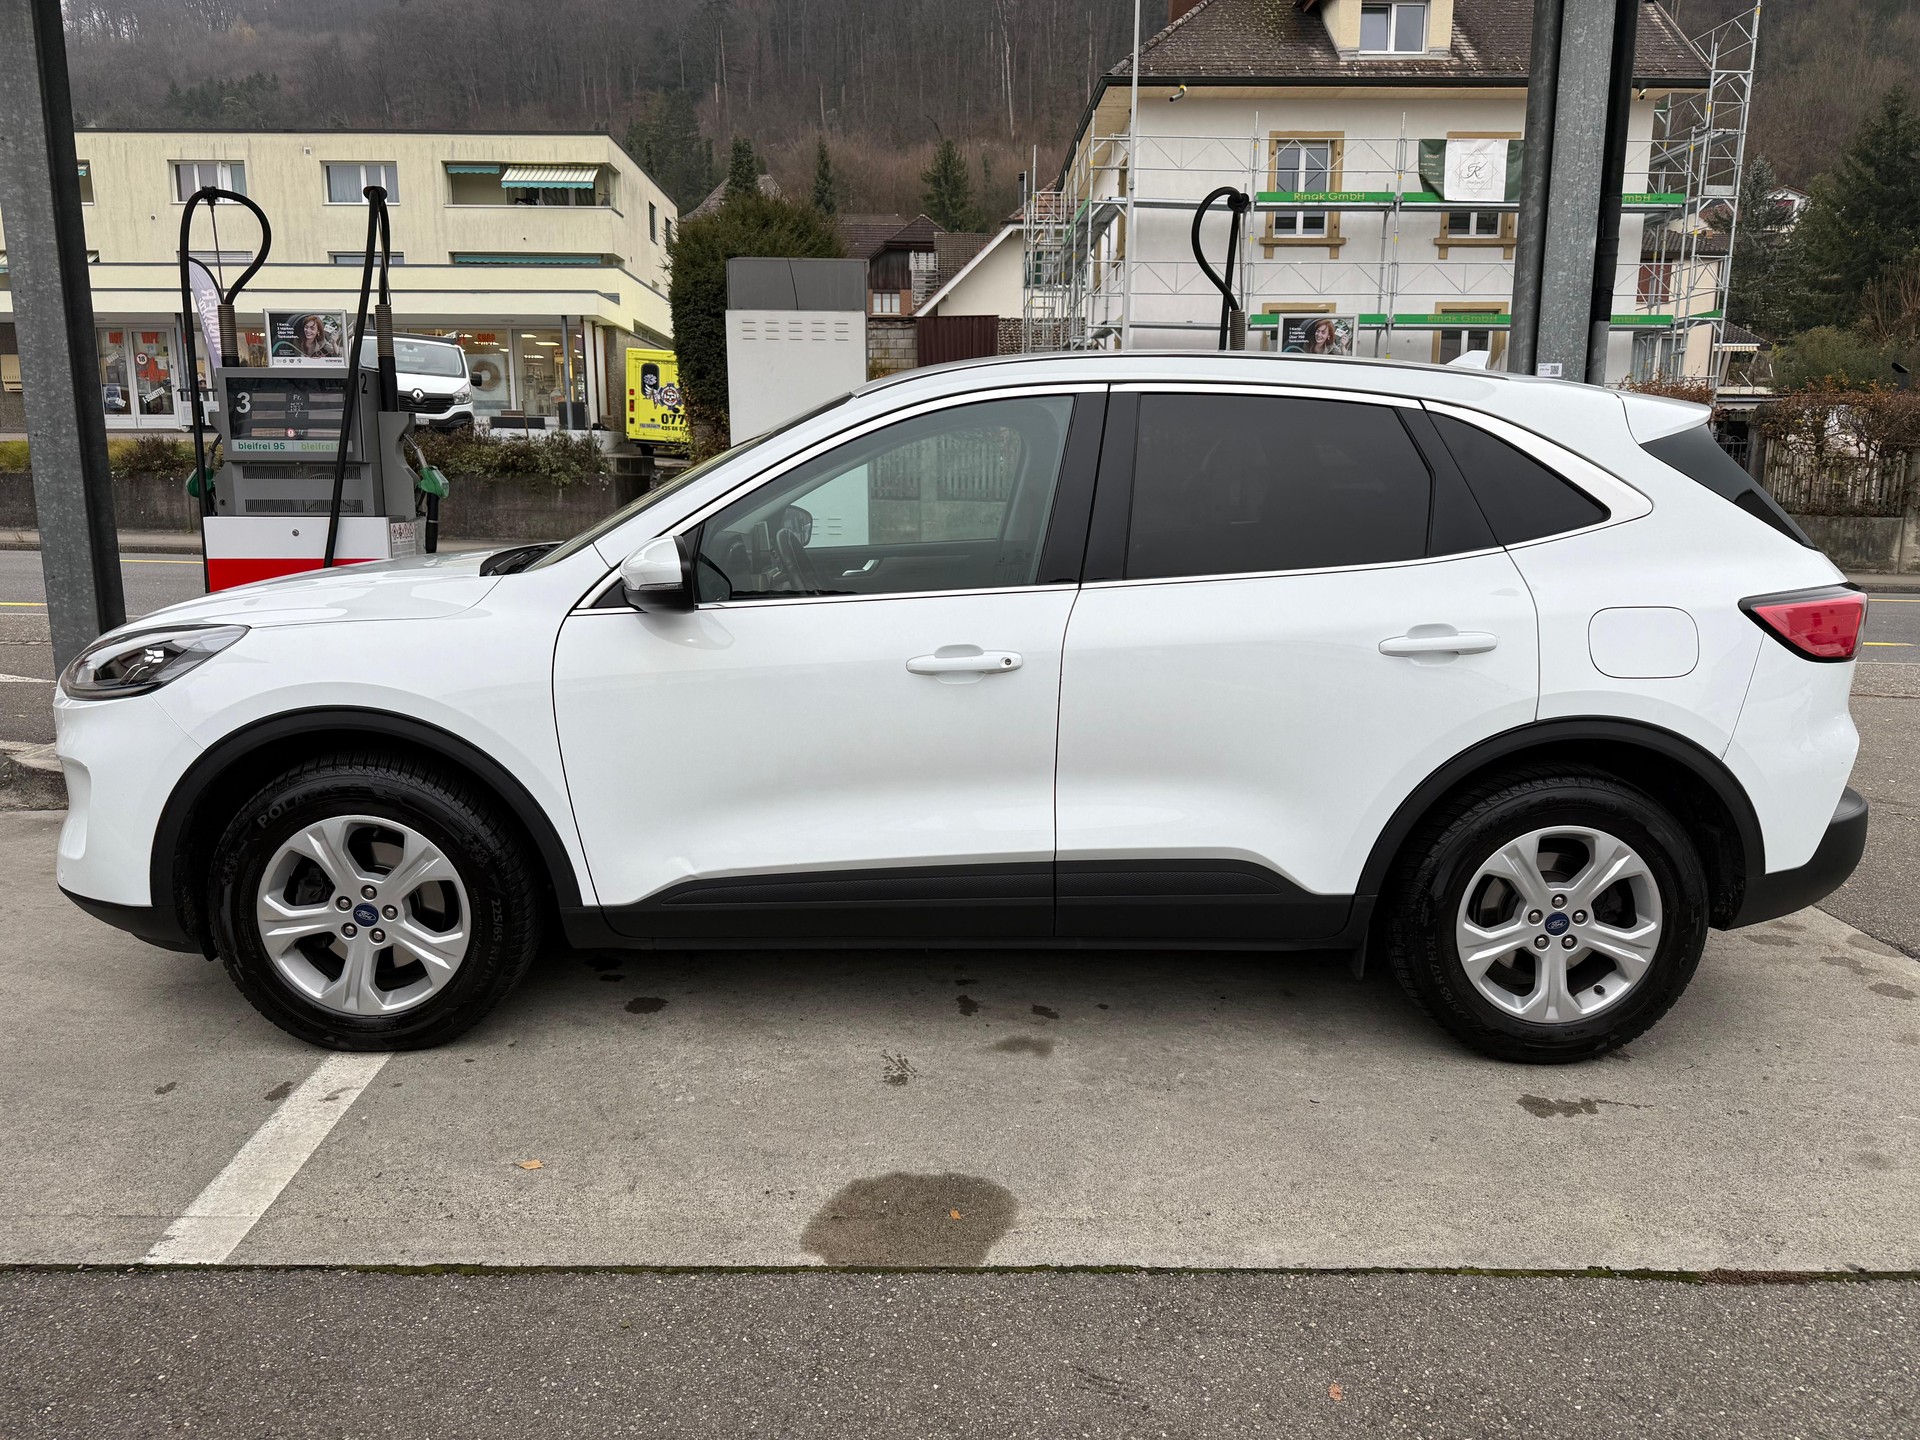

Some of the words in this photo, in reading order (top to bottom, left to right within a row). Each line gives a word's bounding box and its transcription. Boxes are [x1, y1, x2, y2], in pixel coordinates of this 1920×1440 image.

[1294, 192, 1325, 200] Rinak
[1328, 192, 1365, 200] GmbH
[1624, 194, 1651, 202] mbH
[361, 373, 368, 394] 2
[236, 392, 251, 413] 3
[238, 442, 271, 450] bleifrei
[274, 442, 286, 450] 95
[301, 443, 334, 451] bleifrei
[357, 910, 376, 920] Ford
[491, 898, 504, 942] 225/65
[1549, 920, 1567, 929] Ford
